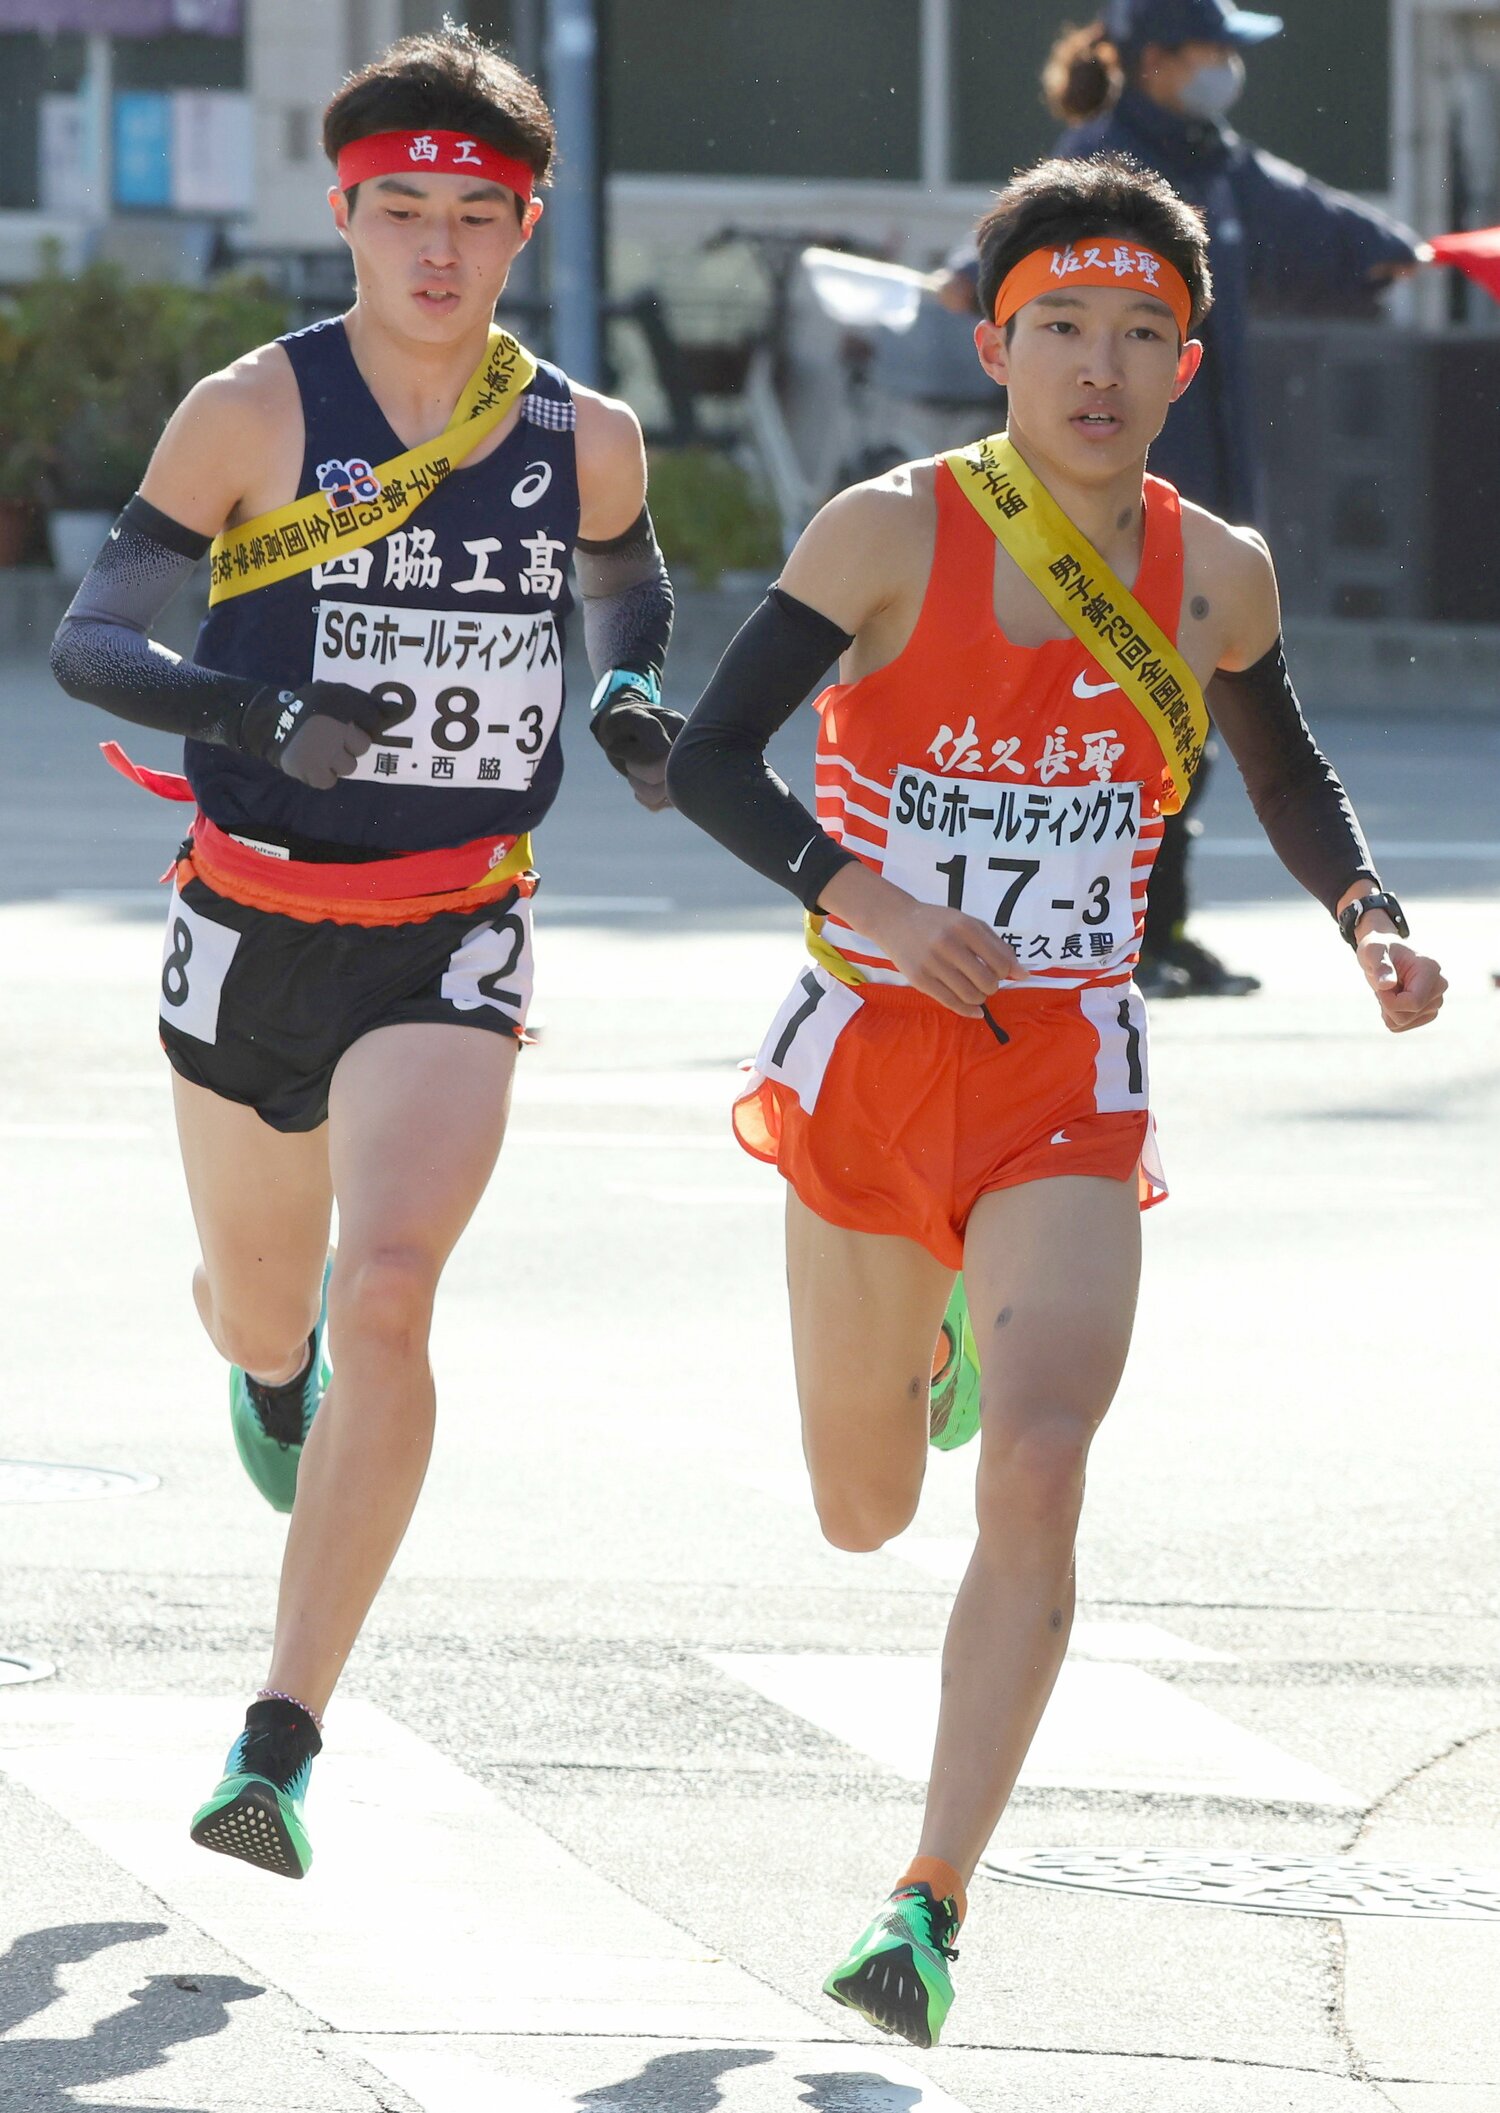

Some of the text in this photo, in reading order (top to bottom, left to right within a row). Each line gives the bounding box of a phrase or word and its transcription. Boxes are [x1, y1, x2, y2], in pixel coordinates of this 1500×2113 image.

[409, 135, 482, 166] 西工
[1049, 244, 1160, 288] 佐久長聖
[322, 609, 559, 672] SGホールディングス
[368, 680, 544, 755] 28-3
[926, 715, 1126, 786] 佐久長聖
[895, 774, 1137, 847] SGホールディングス
[935, 854, 1112, 928] 17-3
[162, 916, 193, 1008] 8
[477, 913, 526, 1009] 2
[771, 970, 827, 1069] 7
